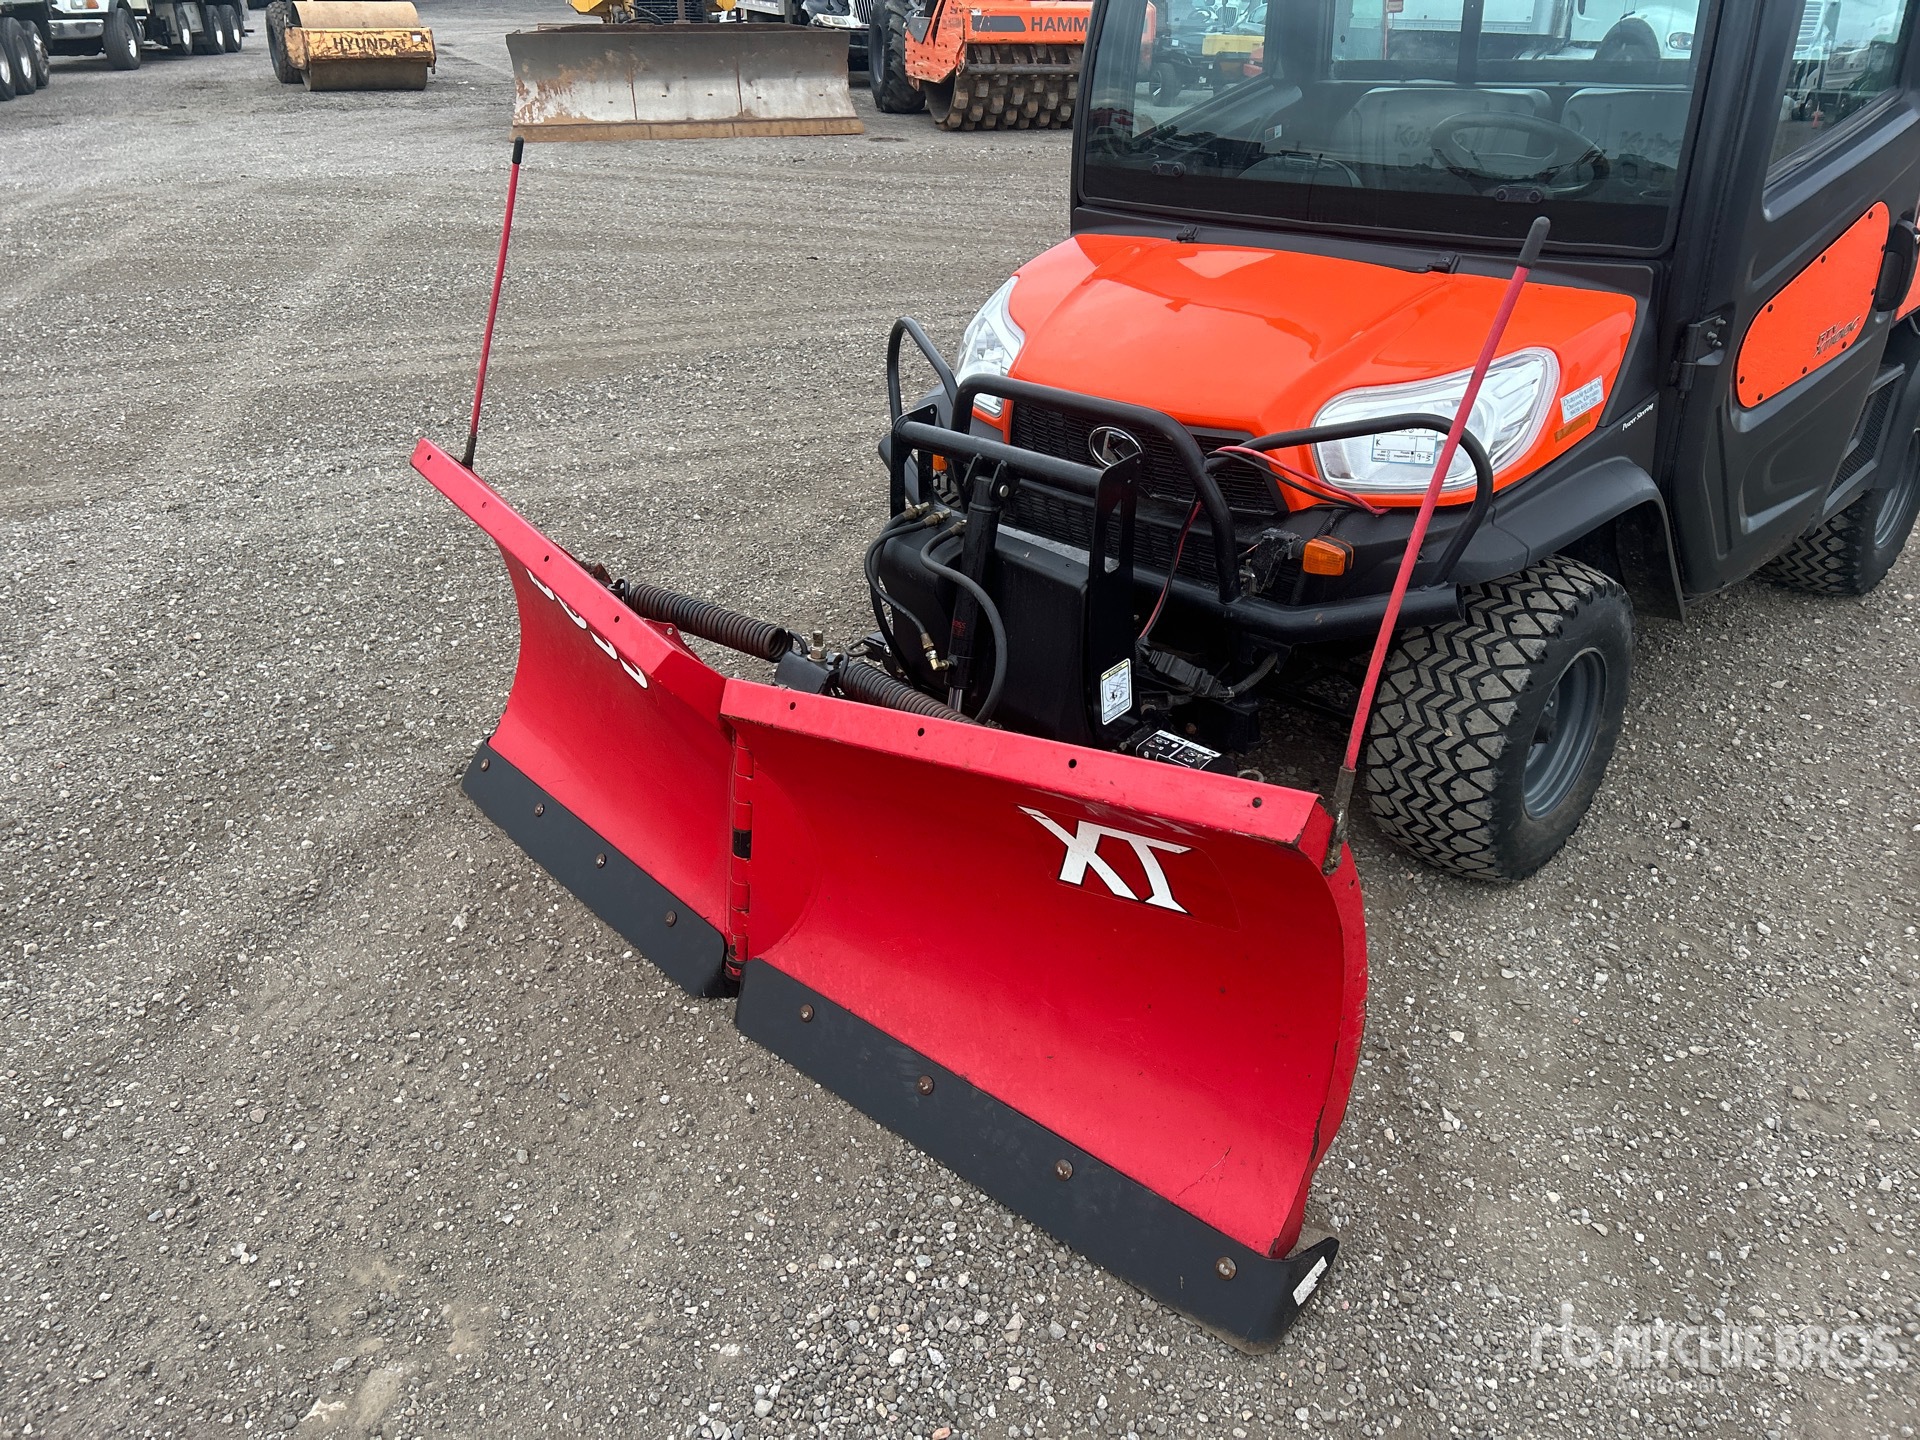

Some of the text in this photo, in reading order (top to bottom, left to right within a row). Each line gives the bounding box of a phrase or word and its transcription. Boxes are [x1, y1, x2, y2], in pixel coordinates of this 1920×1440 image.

[1031, 17, 1089, 32] HAMM
[333, 36, 407, 50] HYUNDAI
[1017, 805, 1192, 913] XT
